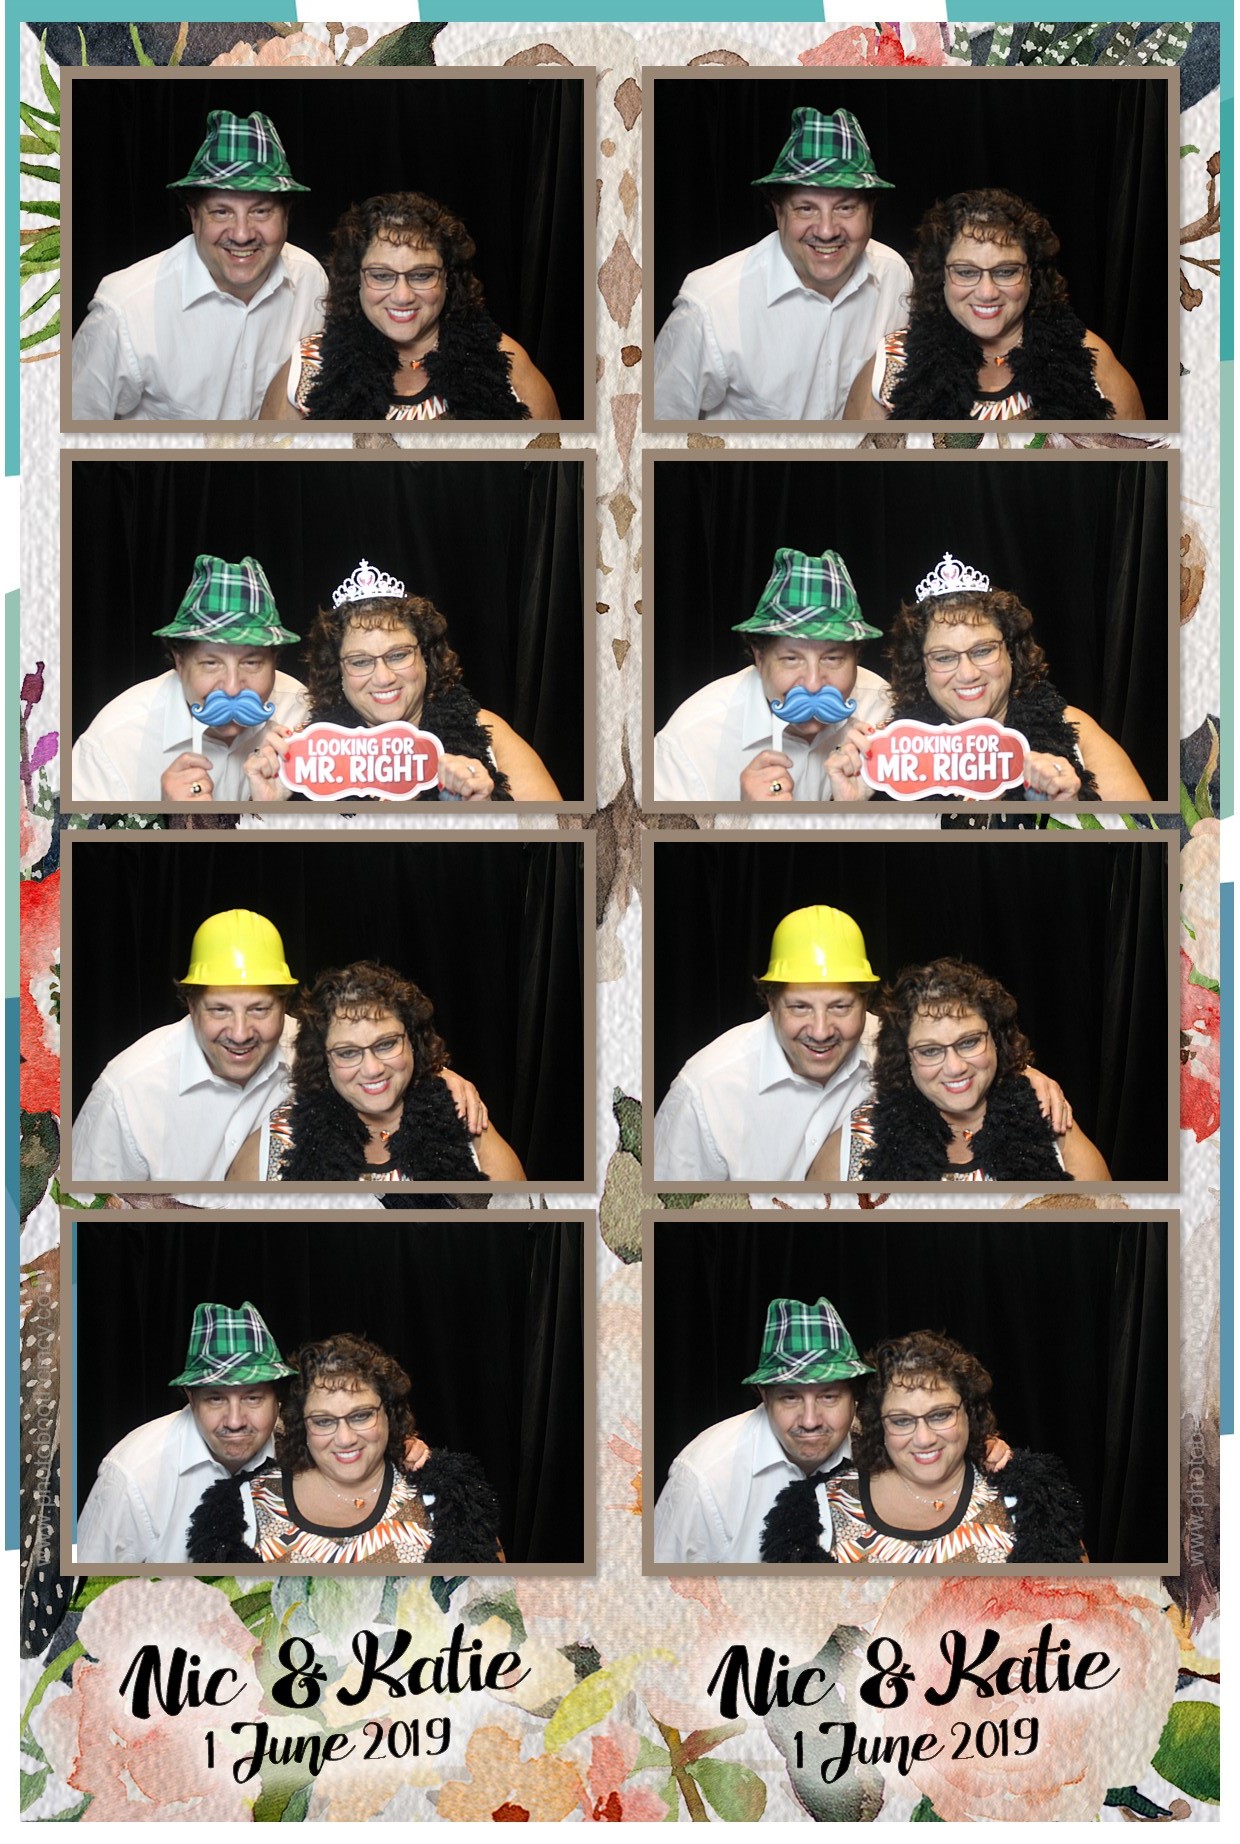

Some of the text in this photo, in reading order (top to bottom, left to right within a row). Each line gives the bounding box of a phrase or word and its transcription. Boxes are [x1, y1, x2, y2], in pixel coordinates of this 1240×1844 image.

[307, 737, 414, 756] LOOKING FOR
[890, 734, 1000, 754] LOOKING FOR
[294, 753, 429, 784] MR. RIGHT
[876, 751, 1014, 782] MR. RIGHT
